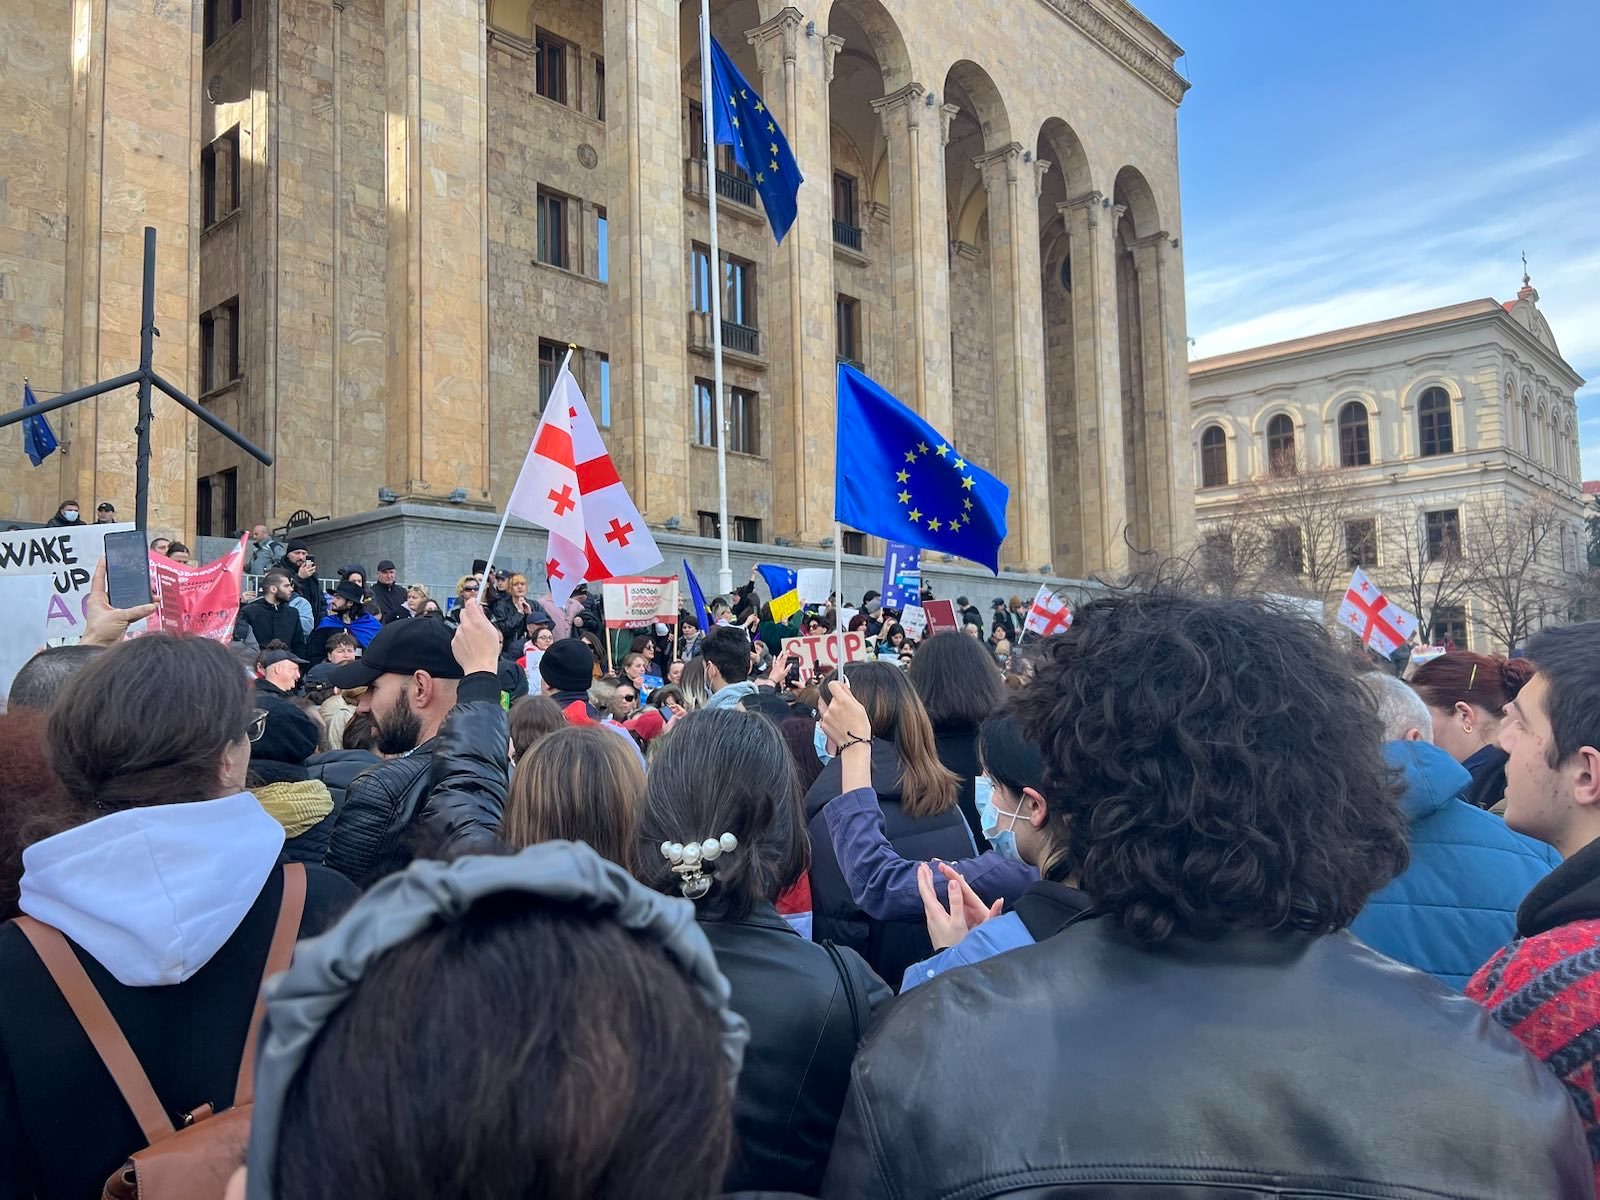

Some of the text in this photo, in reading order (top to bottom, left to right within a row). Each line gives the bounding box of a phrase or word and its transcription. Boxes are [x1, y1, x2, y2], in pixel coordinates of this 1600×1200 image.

[0, 535, 78, 569] WAKE
[52, 568, 90, 594] UP
[786, 634, 861, 667] STOP
